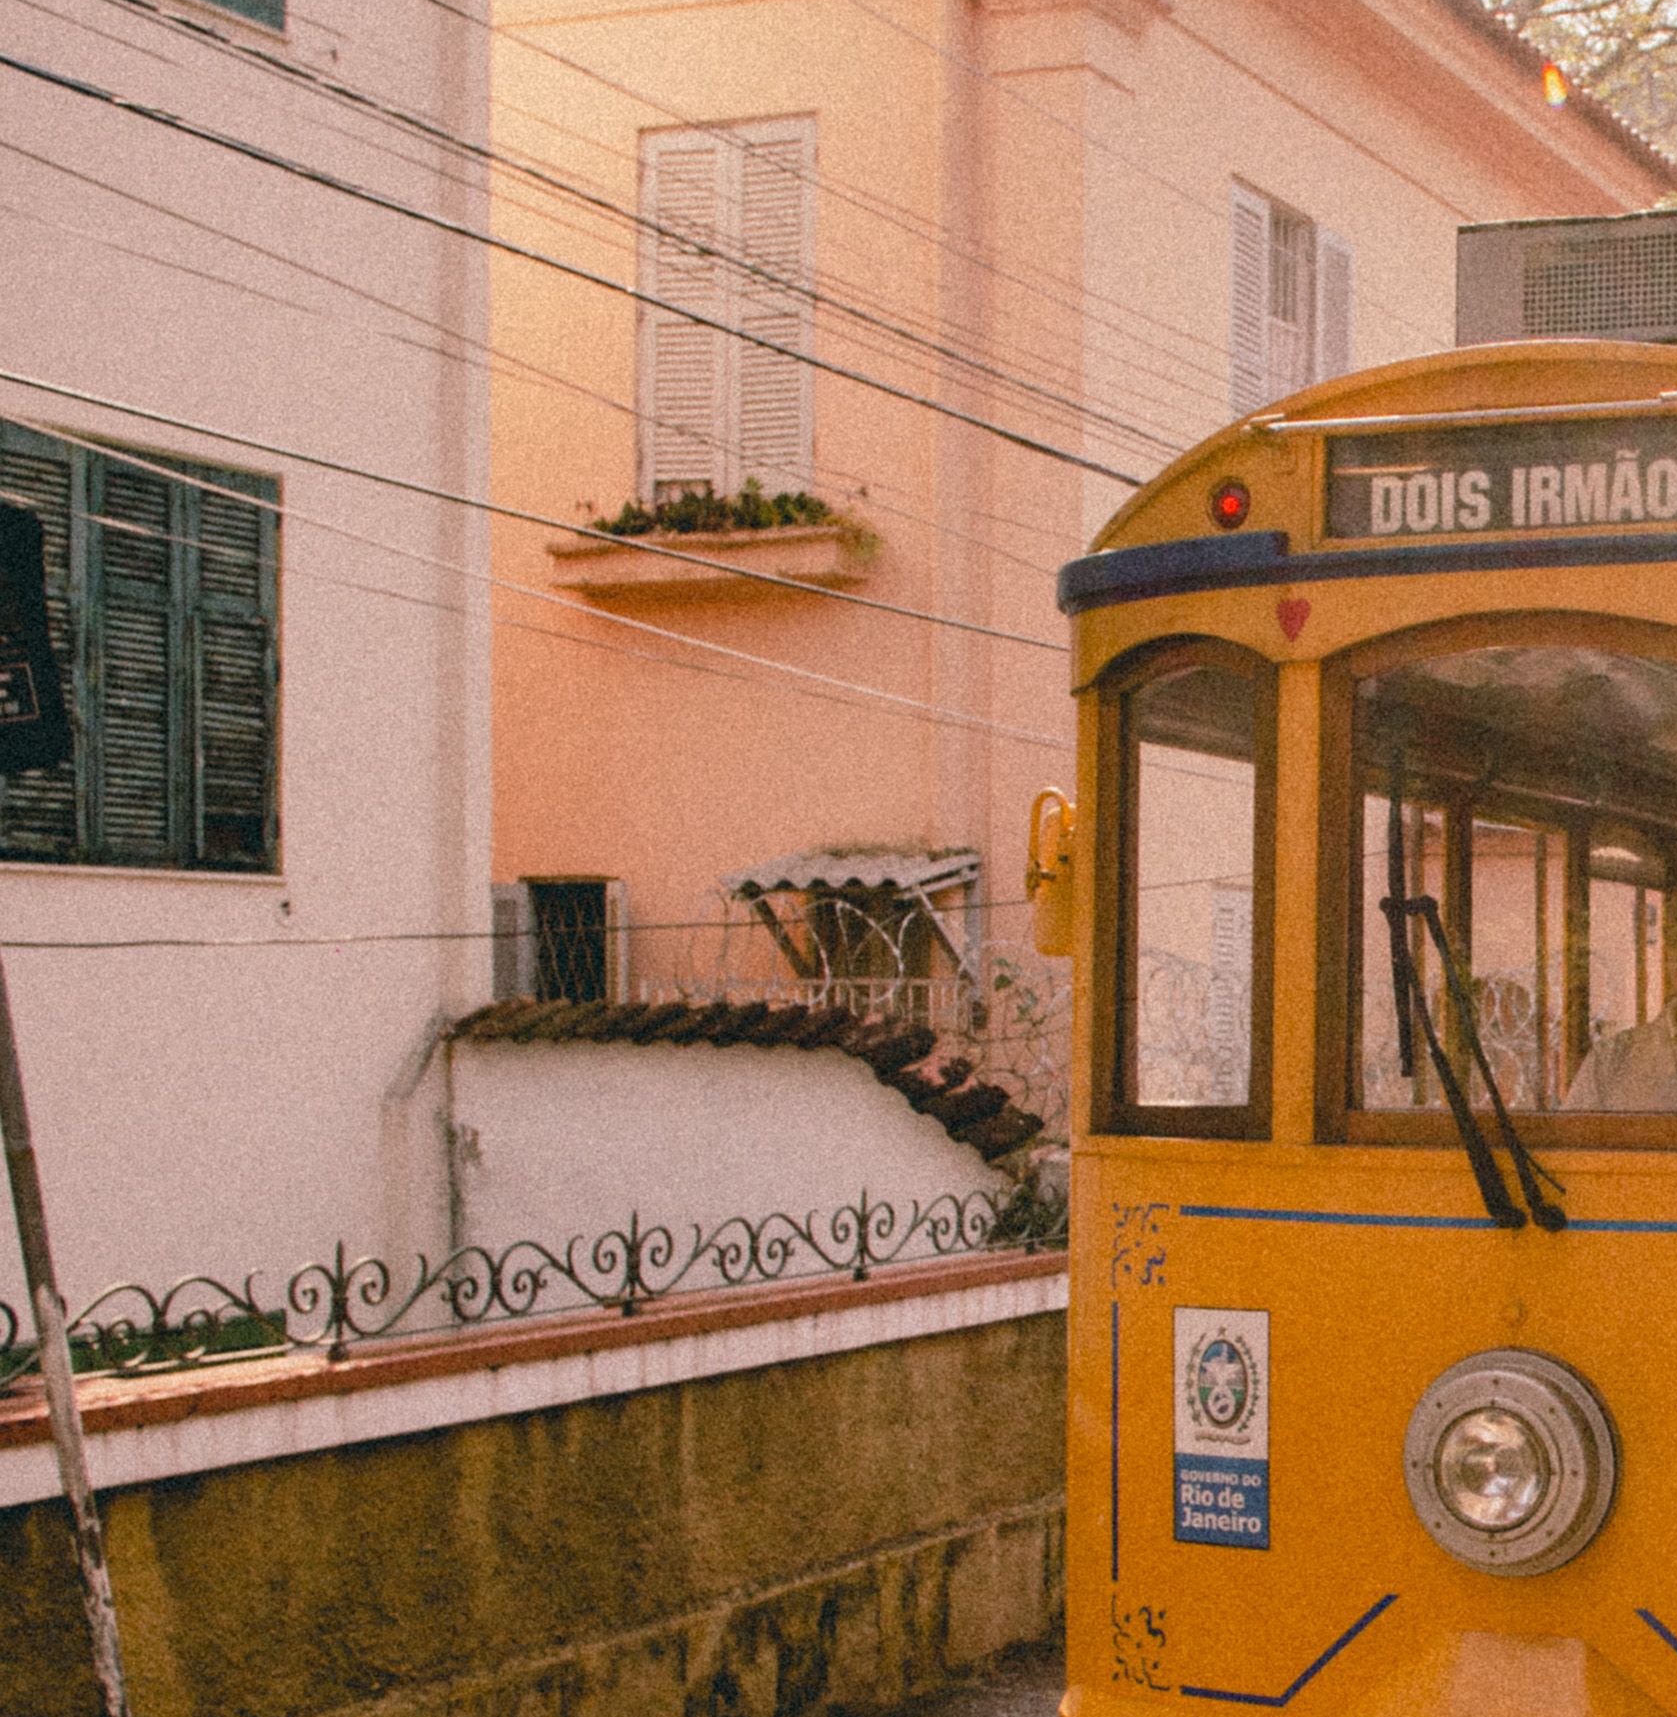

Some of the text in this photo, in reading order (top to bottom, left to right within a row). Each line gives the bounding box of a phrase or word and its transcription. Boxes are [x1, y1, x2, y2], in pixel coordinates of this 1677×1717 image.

[1370, 470, 1490, 534] DOIS
[1242, 1474, 1260, 1487] DO
[1181, 1484, 1245, 1508] Rio de
[1182, 1507, 1261, 1533] Janeiro
